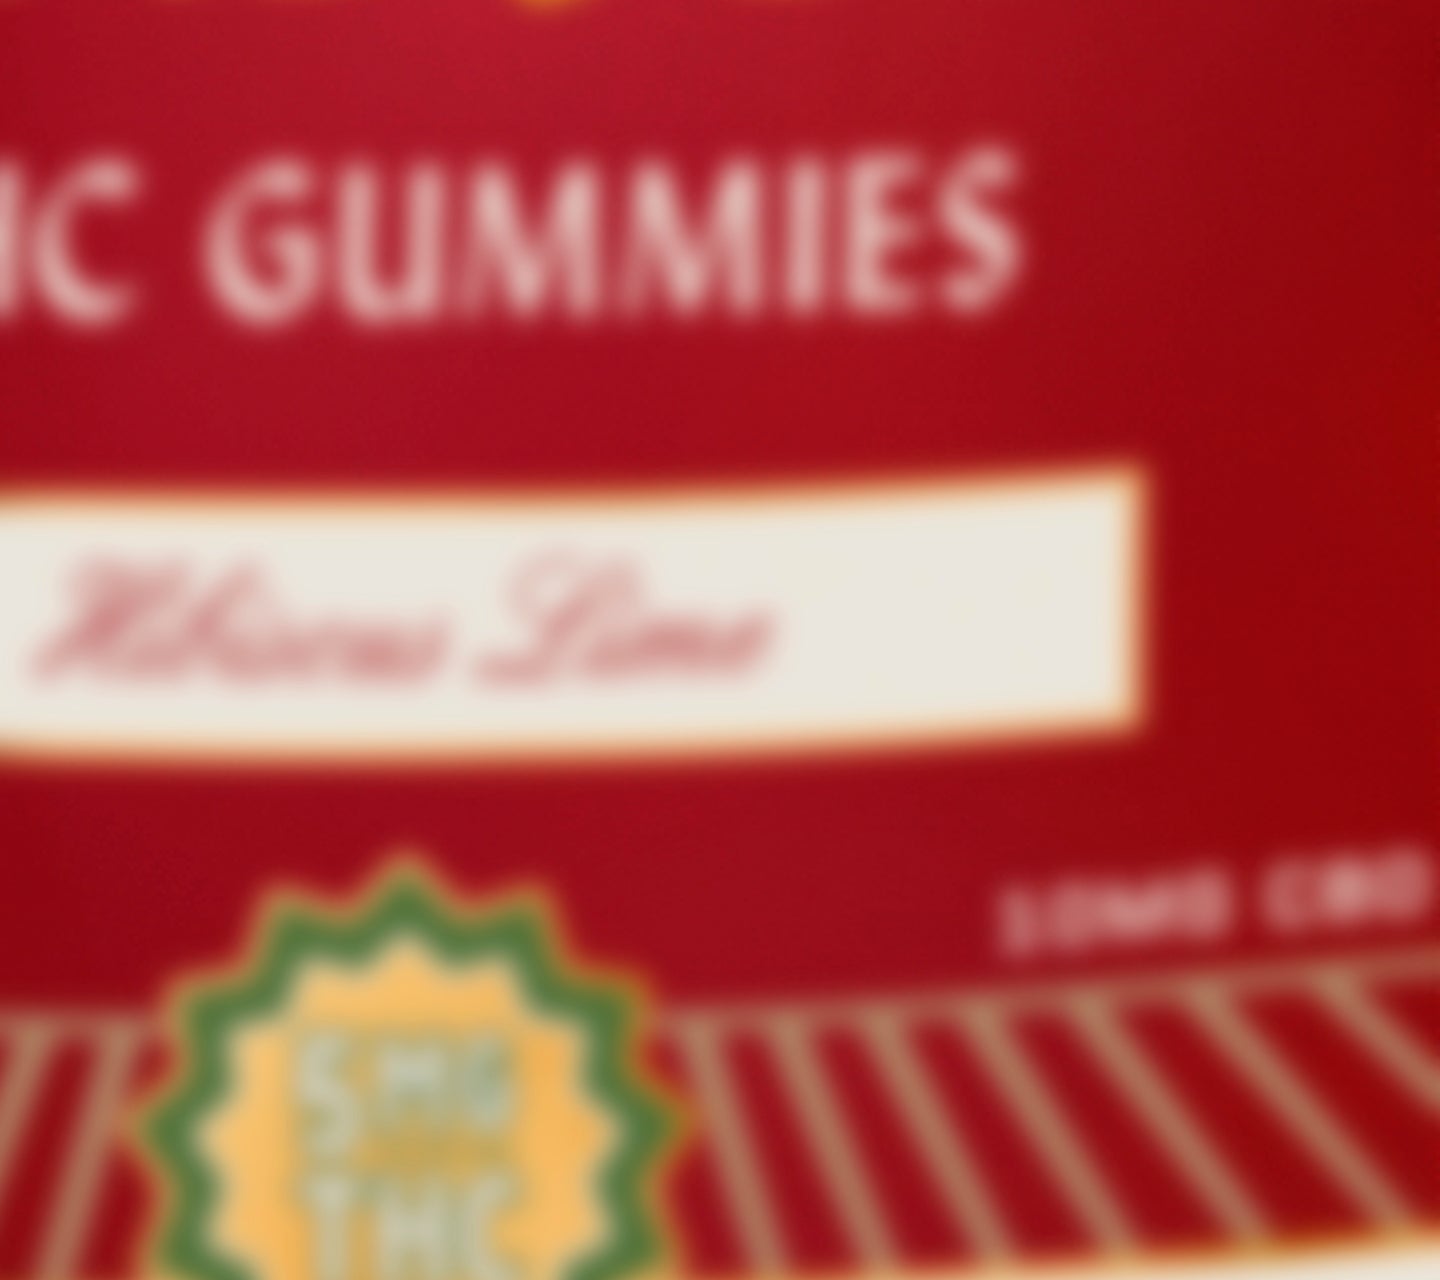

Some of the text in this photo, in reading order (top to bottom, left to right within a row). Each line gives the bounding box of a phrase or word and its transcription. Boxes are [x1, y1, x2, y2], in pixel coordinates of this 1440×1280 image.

[202, 145, 1028, 330] GUMMIES
[30, 545, 782, 692] Hibiscus Lime
